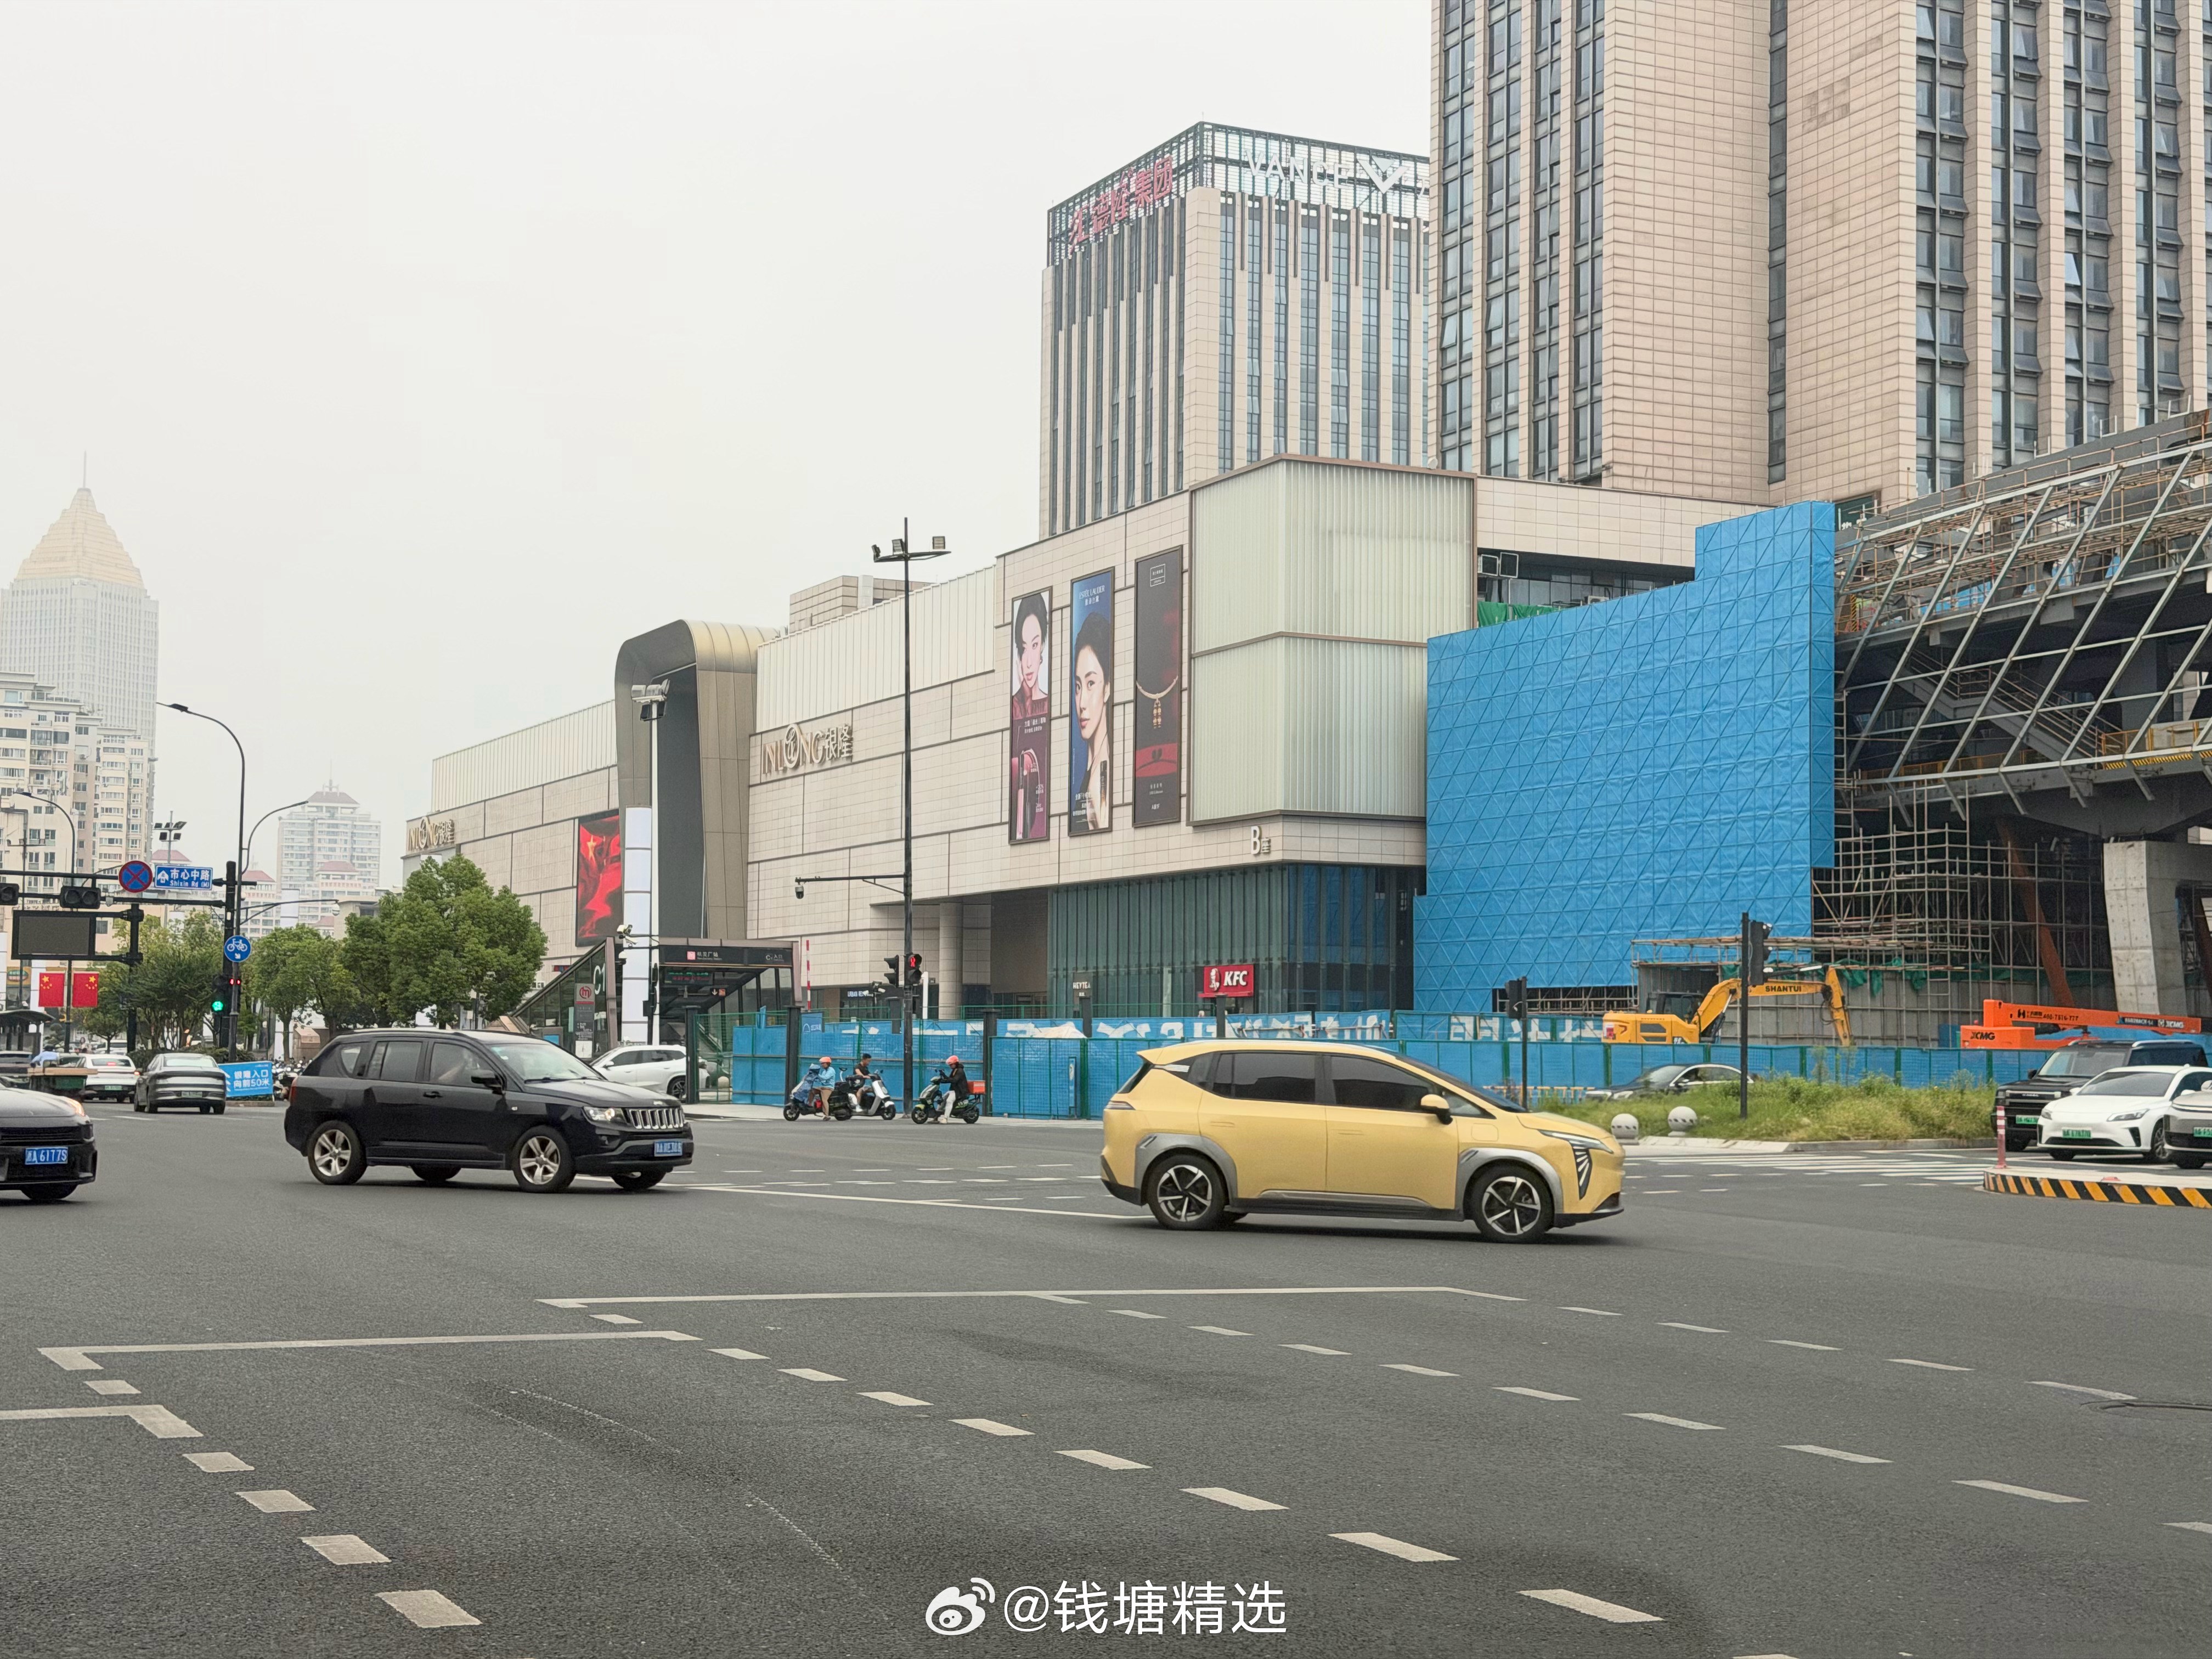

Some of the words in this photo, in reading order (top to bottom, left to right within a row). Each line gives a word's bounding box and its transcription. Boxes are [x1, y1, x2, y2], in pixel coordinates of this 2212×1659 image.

[1245, 150, 1350, 189] VANCE
[170, 868, 210, 881] 市心中路
[1223, 970, 1248, 986] KFC
[1970, 1031, 1995, 1041] XCMG
